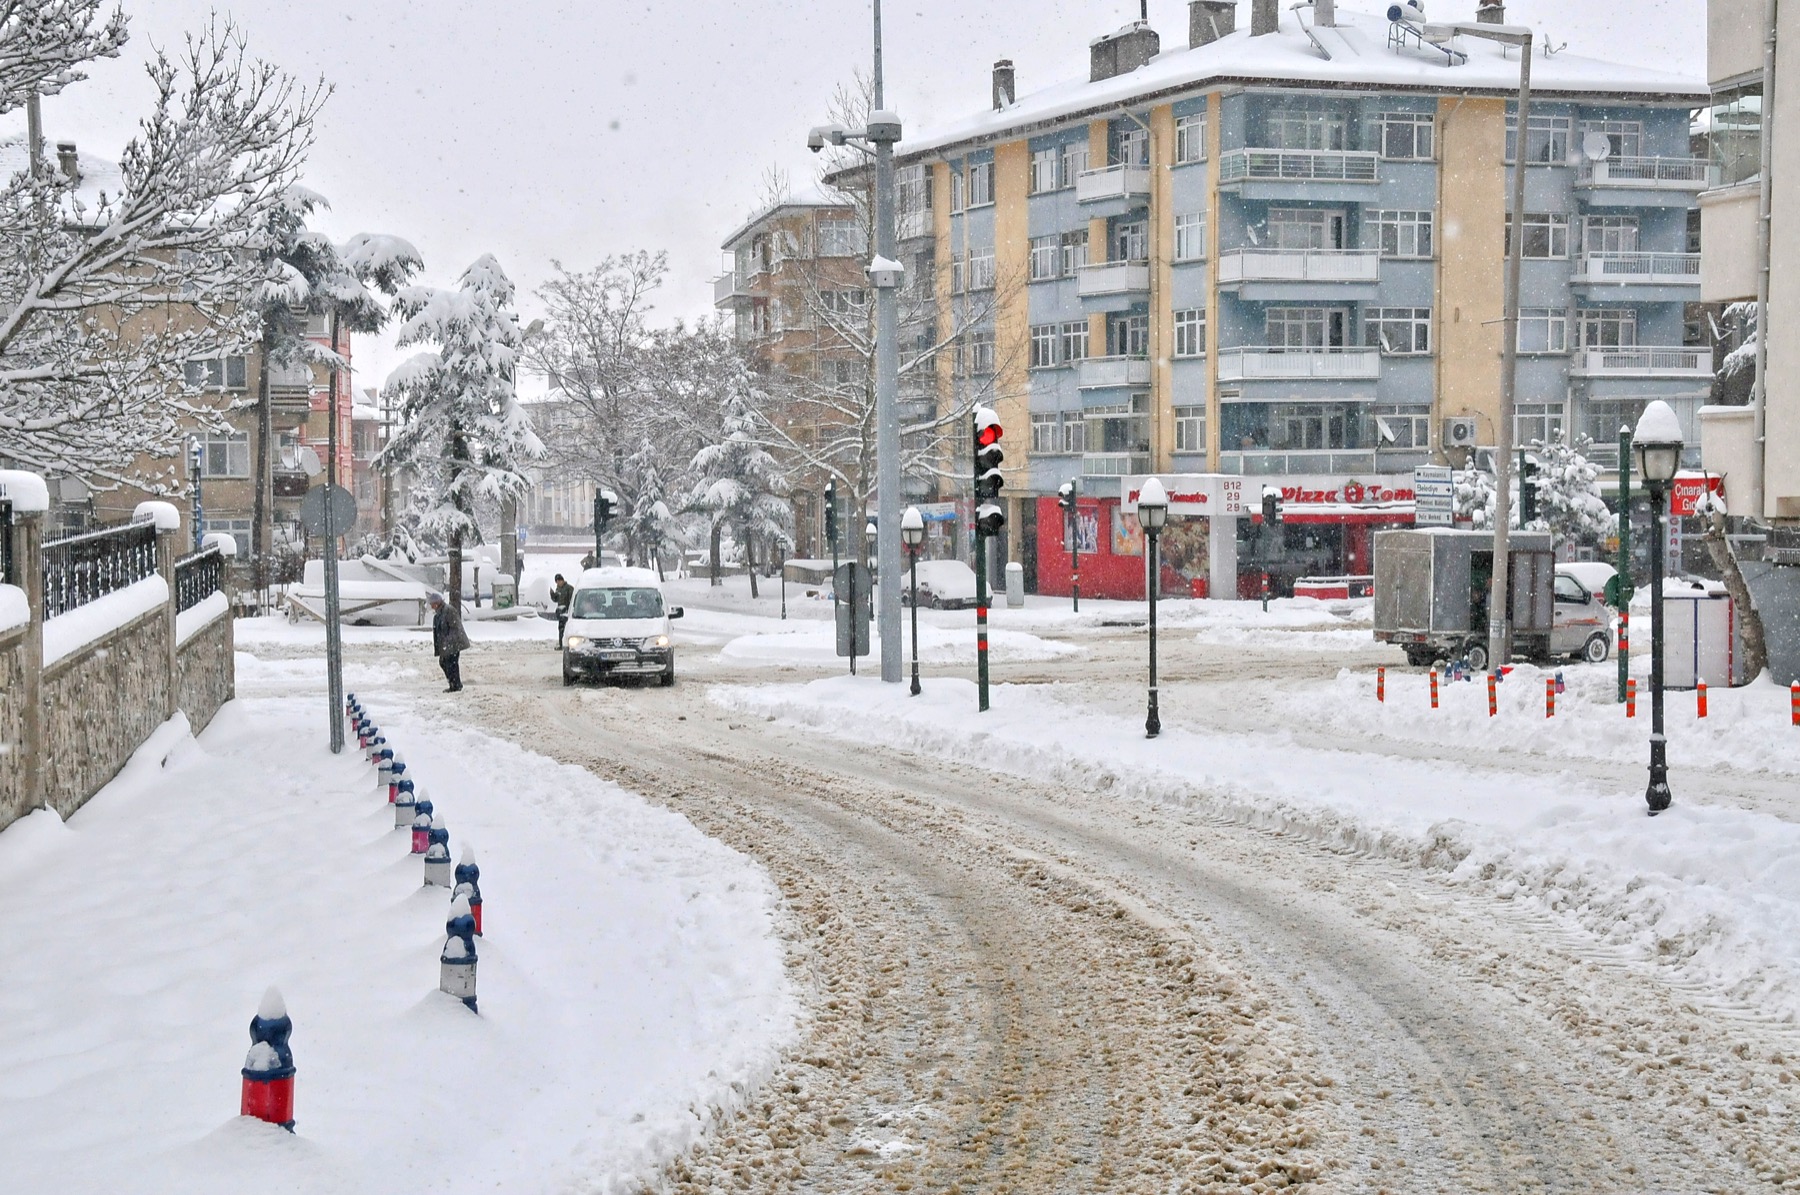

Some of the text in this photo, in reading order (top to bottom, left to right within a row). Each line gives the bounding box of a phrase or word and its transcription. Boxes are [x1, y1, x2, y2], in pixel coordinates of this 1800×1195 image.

[1224, 481, 1242, 490] 812
[1675, 483, 1707, 499] Çınaralt
[1167, 491, 1208, 503] Tomato
[1226, 492, 1240, 501] 29
[1281, 486, 1338, 503] Pizza
[1226, 503, 1240, 512] 29
[1682, 497, 1698, 511] Gıd
